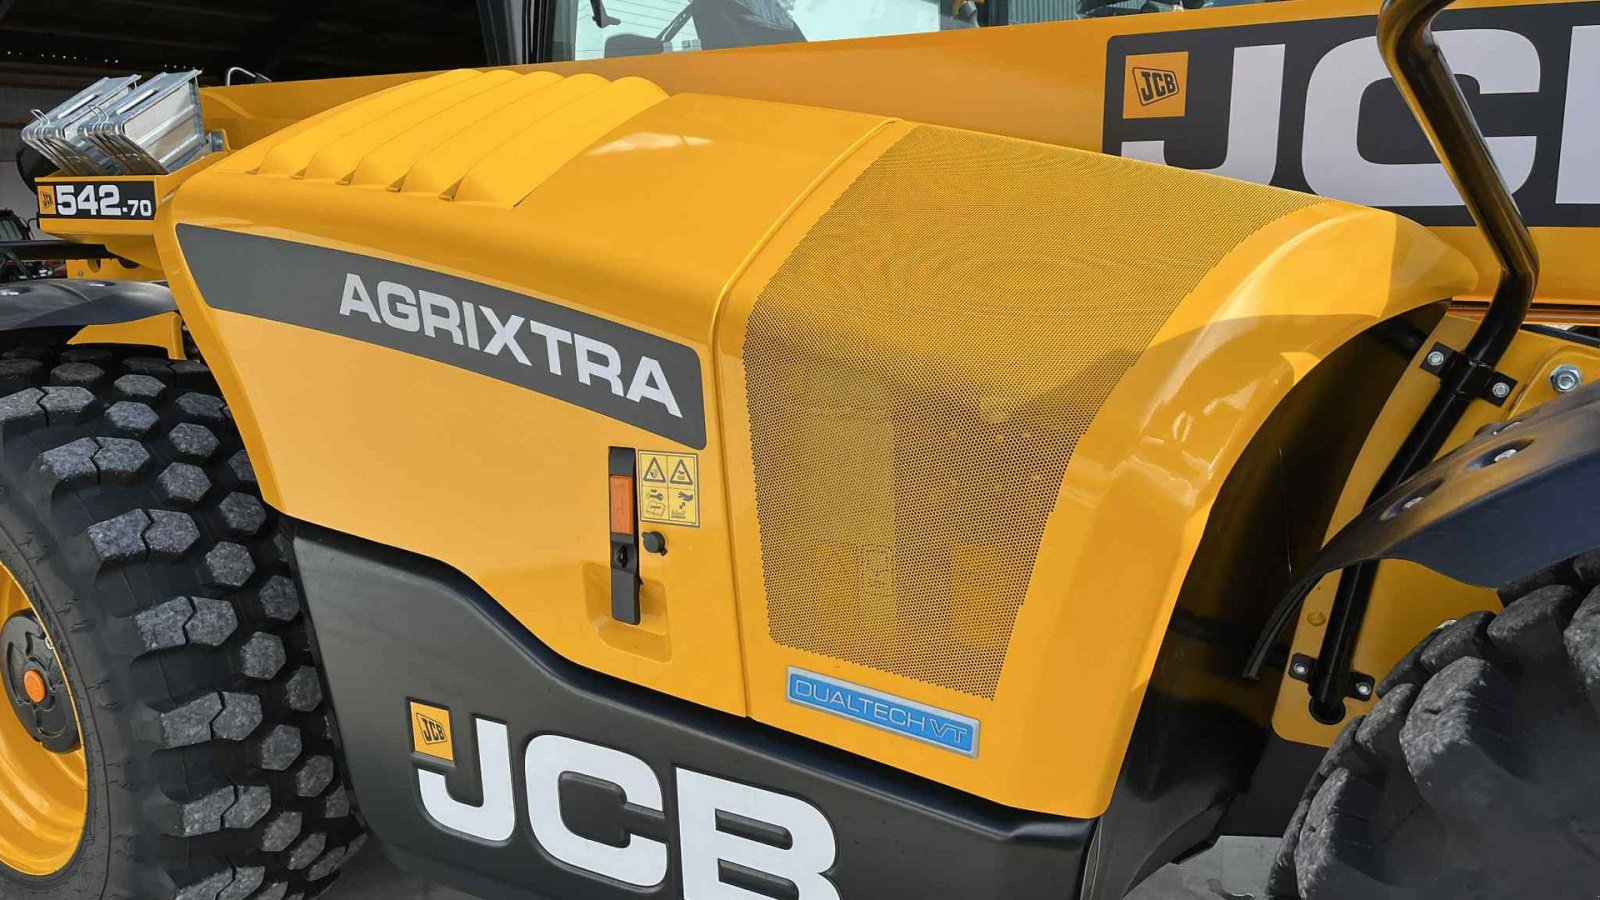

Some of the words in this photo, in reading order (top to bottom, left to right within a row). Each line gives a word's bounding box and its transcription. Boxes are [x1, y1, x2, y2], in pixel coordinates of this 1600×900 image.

[1121, 25, 1600, 206] JC
[1140, 71, 1177, 101] JCB
[339, 272, 683, 418] AGRIXTRA
[421, 717, 446, 742] JCB
[795, 679, 925, 732] DUALTECH
[929, 718, 968, 745] VT
[418, 717, 841, 900] JCB
